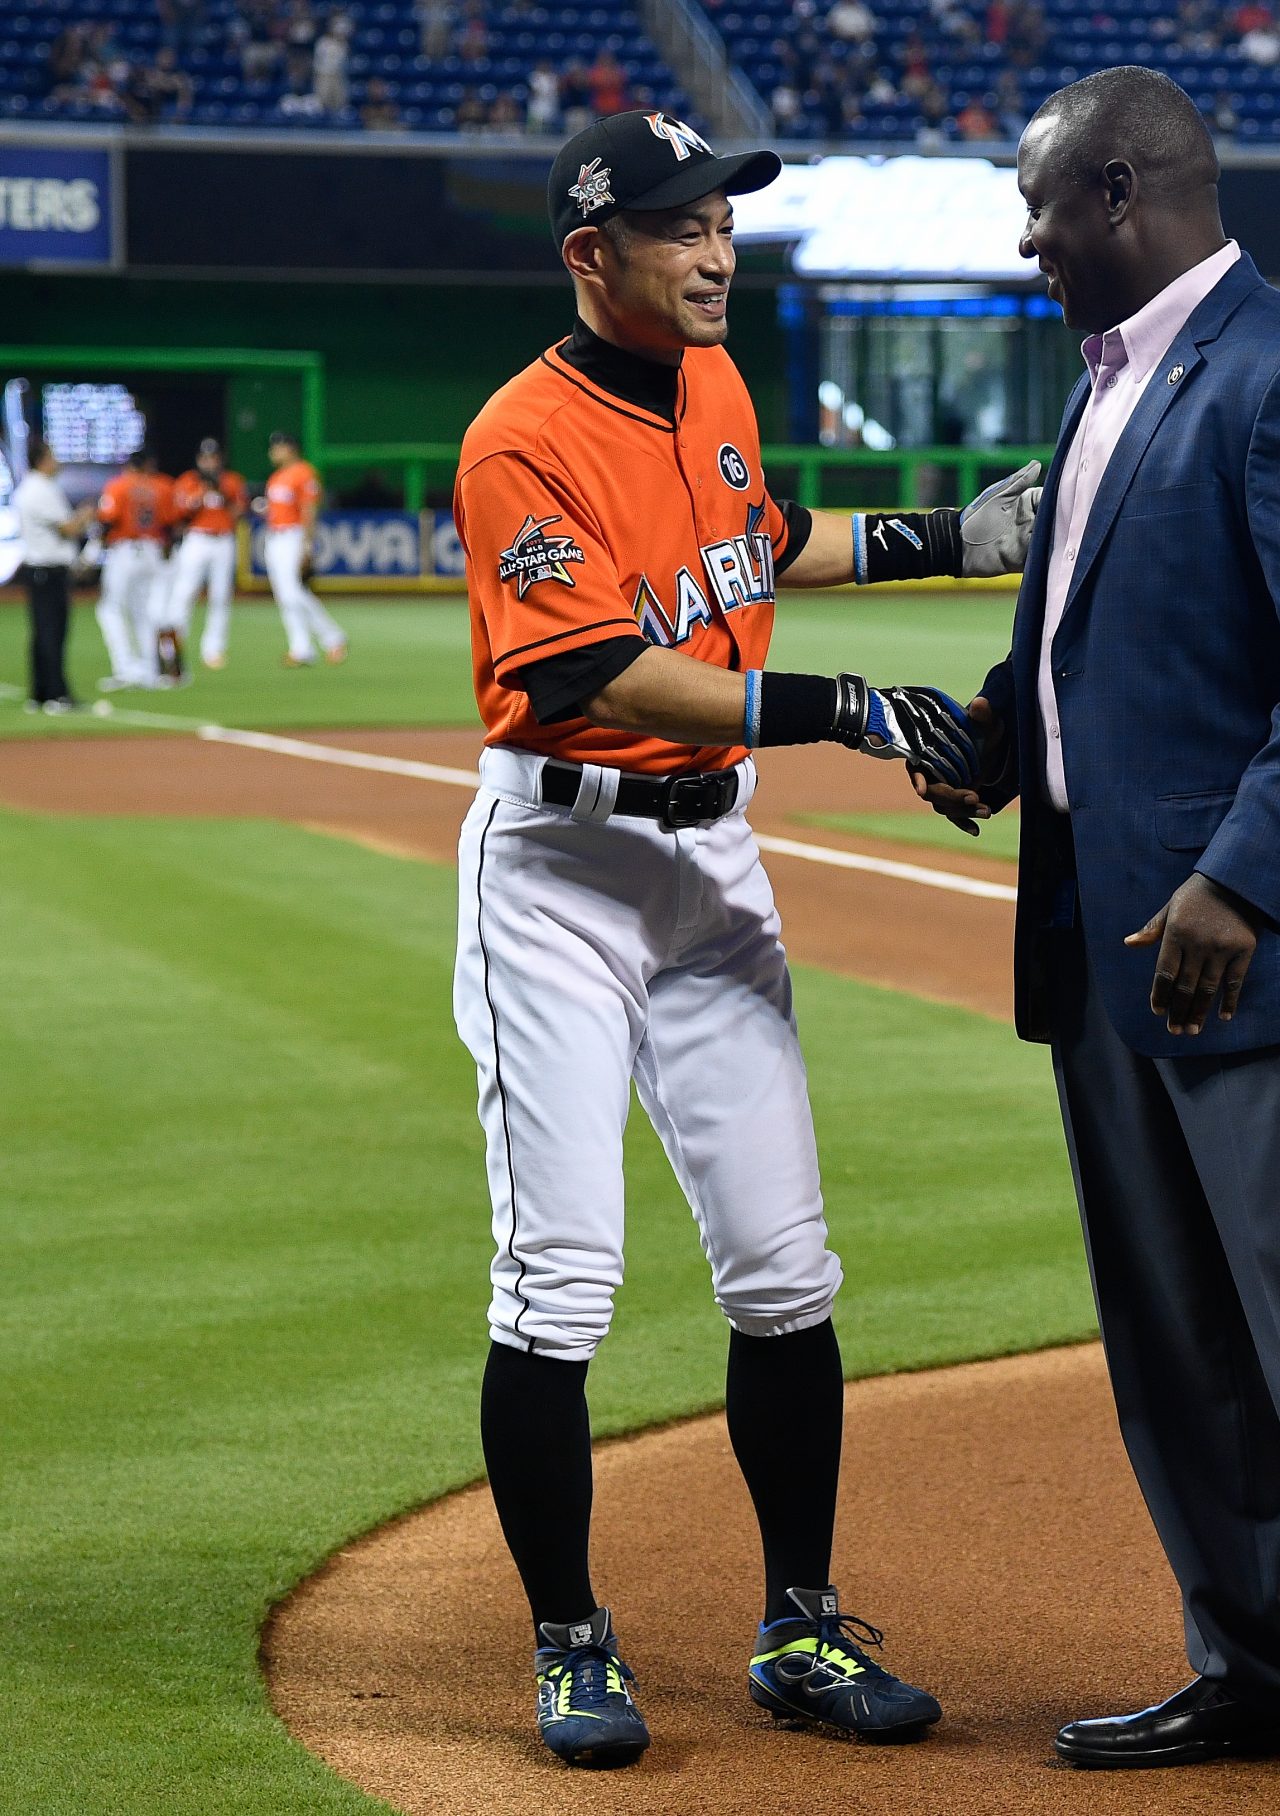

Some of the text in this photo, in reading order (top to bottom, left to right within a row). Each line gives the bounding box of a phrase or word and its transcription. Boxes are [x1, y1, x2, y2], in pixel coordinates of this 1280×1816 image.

[578, 178, 607, 203] ASG
[722, 453, 745, 482] 16
[526, 544, 543, 553] MLB
[547, 548, 585, 561] GAME
